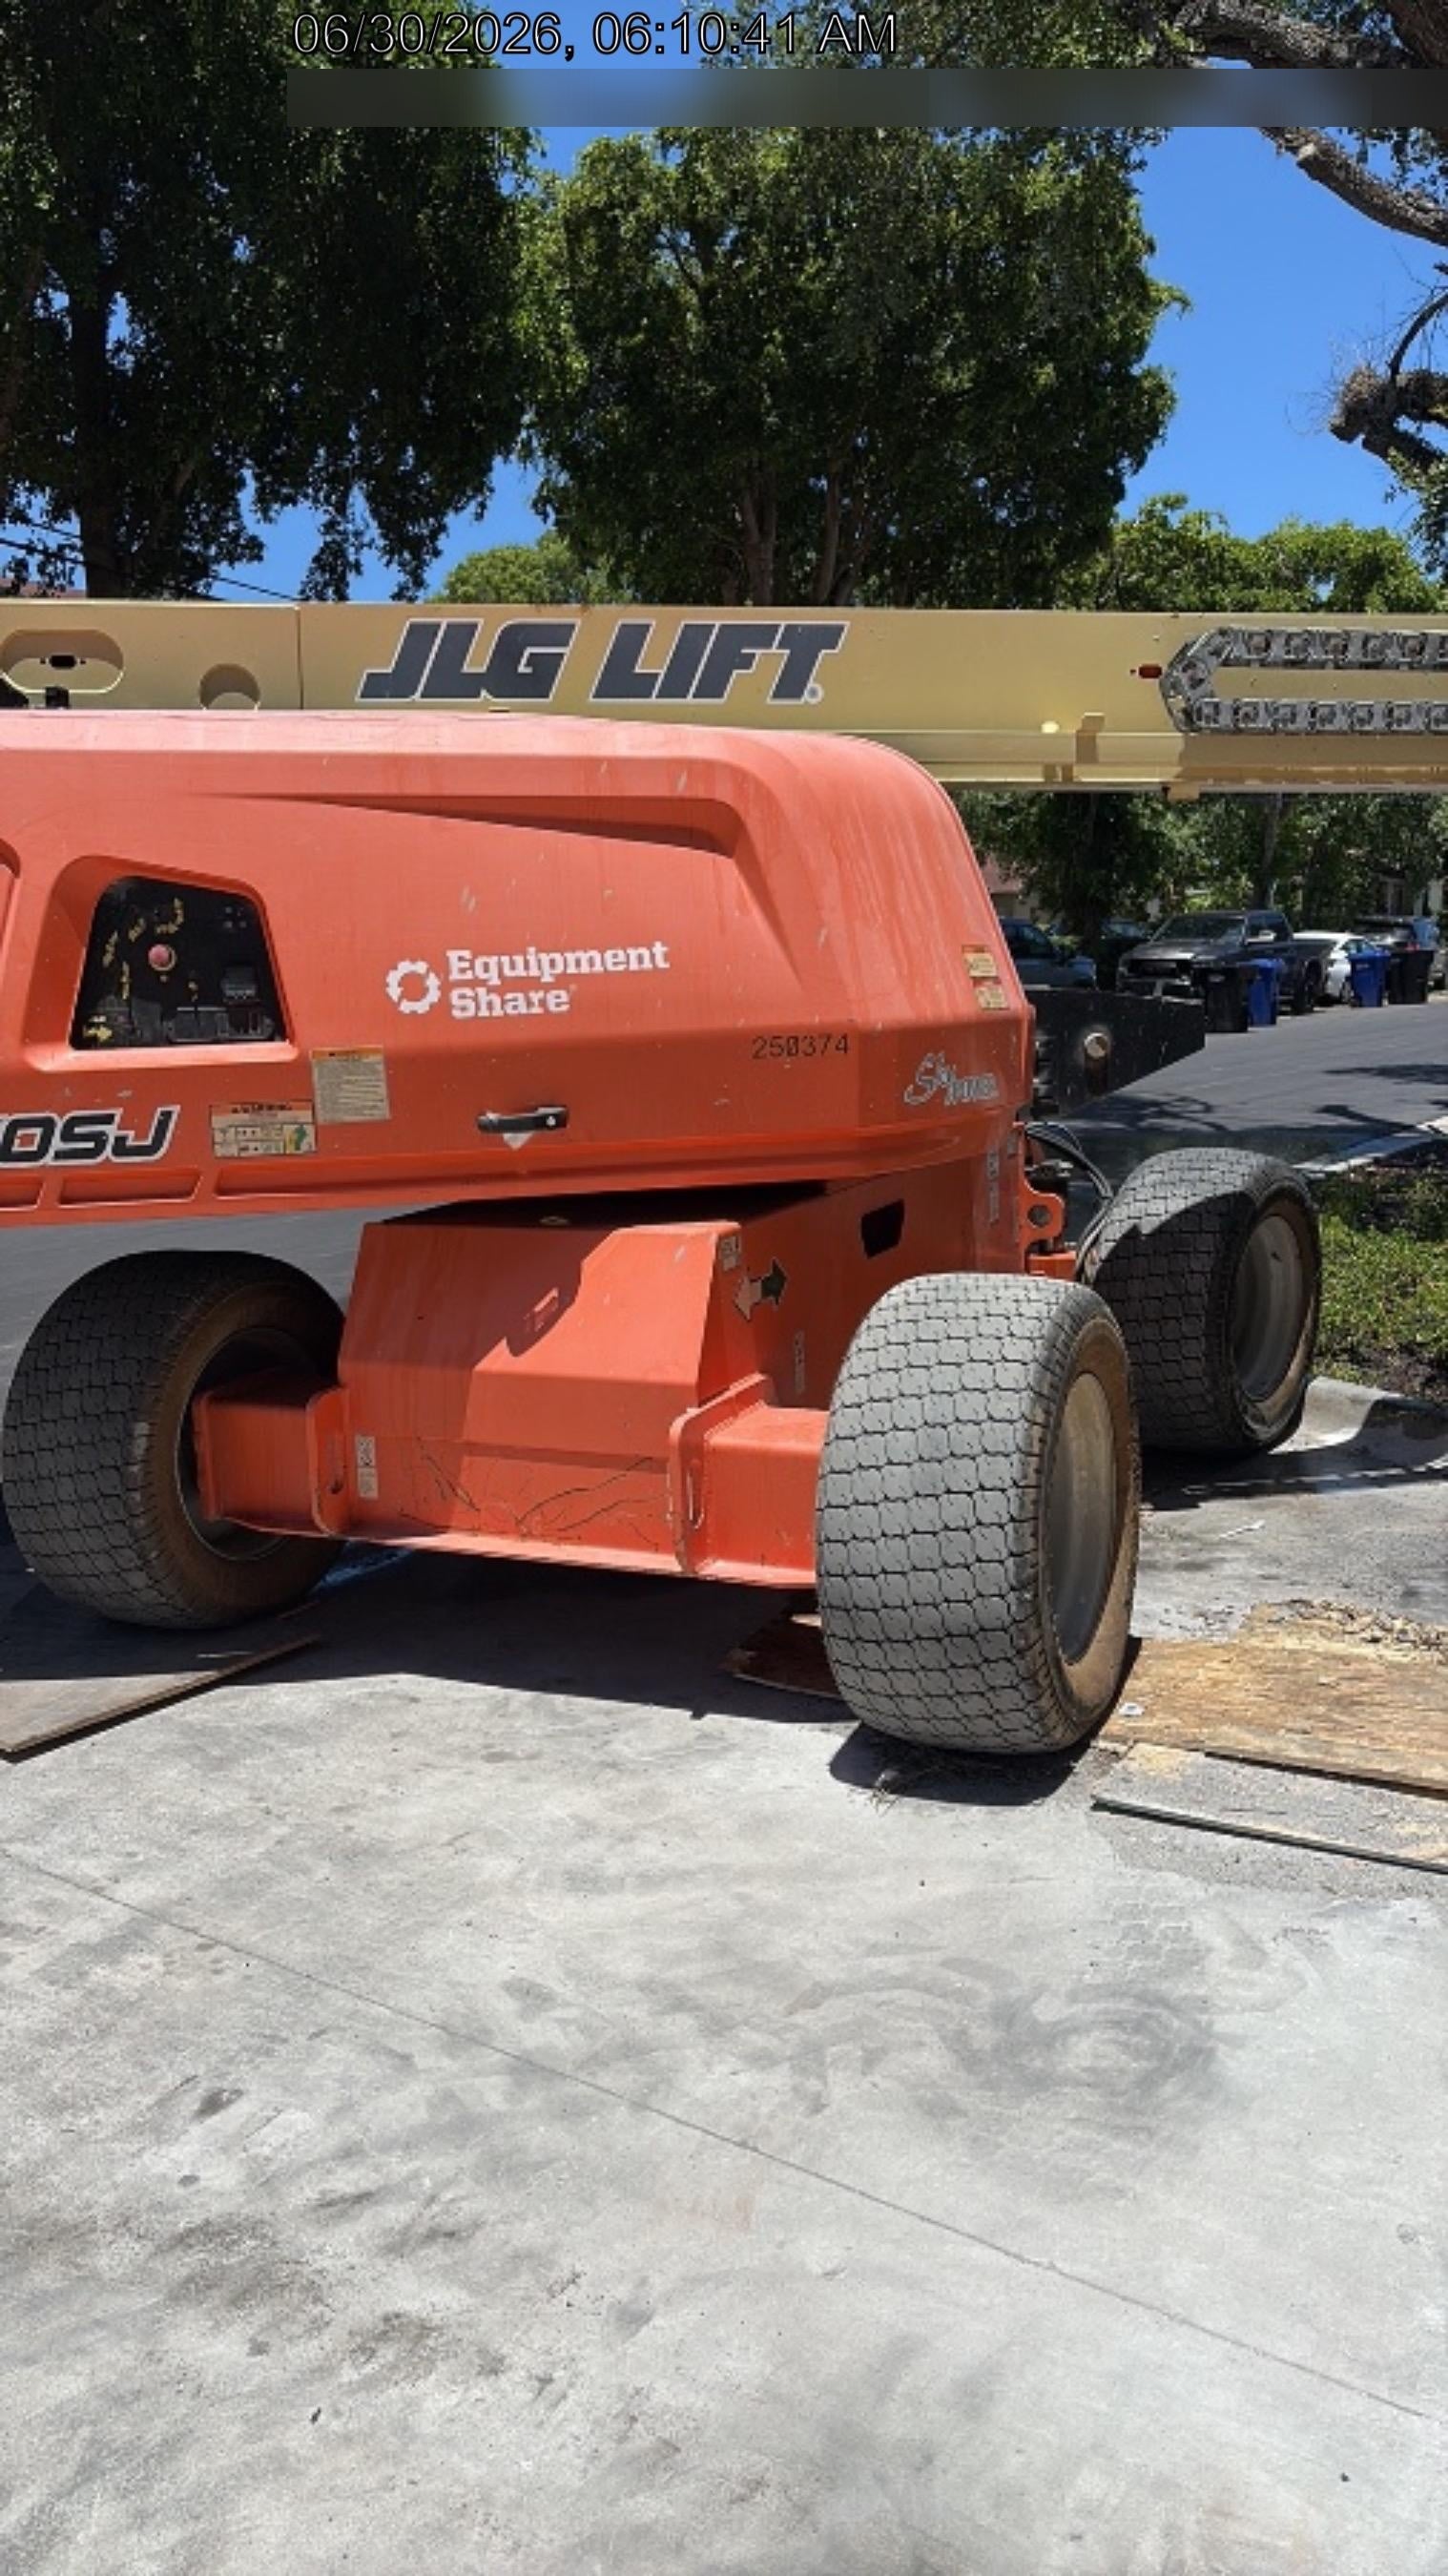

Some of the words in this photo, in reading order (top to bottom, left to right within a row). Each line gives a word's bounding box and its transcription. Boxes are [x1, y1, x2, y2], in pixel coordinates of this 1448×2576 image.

[357, 619, 580, 701] JLG
[446, 941, 671, 986] Equipment
[450, 987, 570, 1020] Share
[752, 1033, 848, 1060] 250374
[0, 1105, 181, 1169] 0SJ
